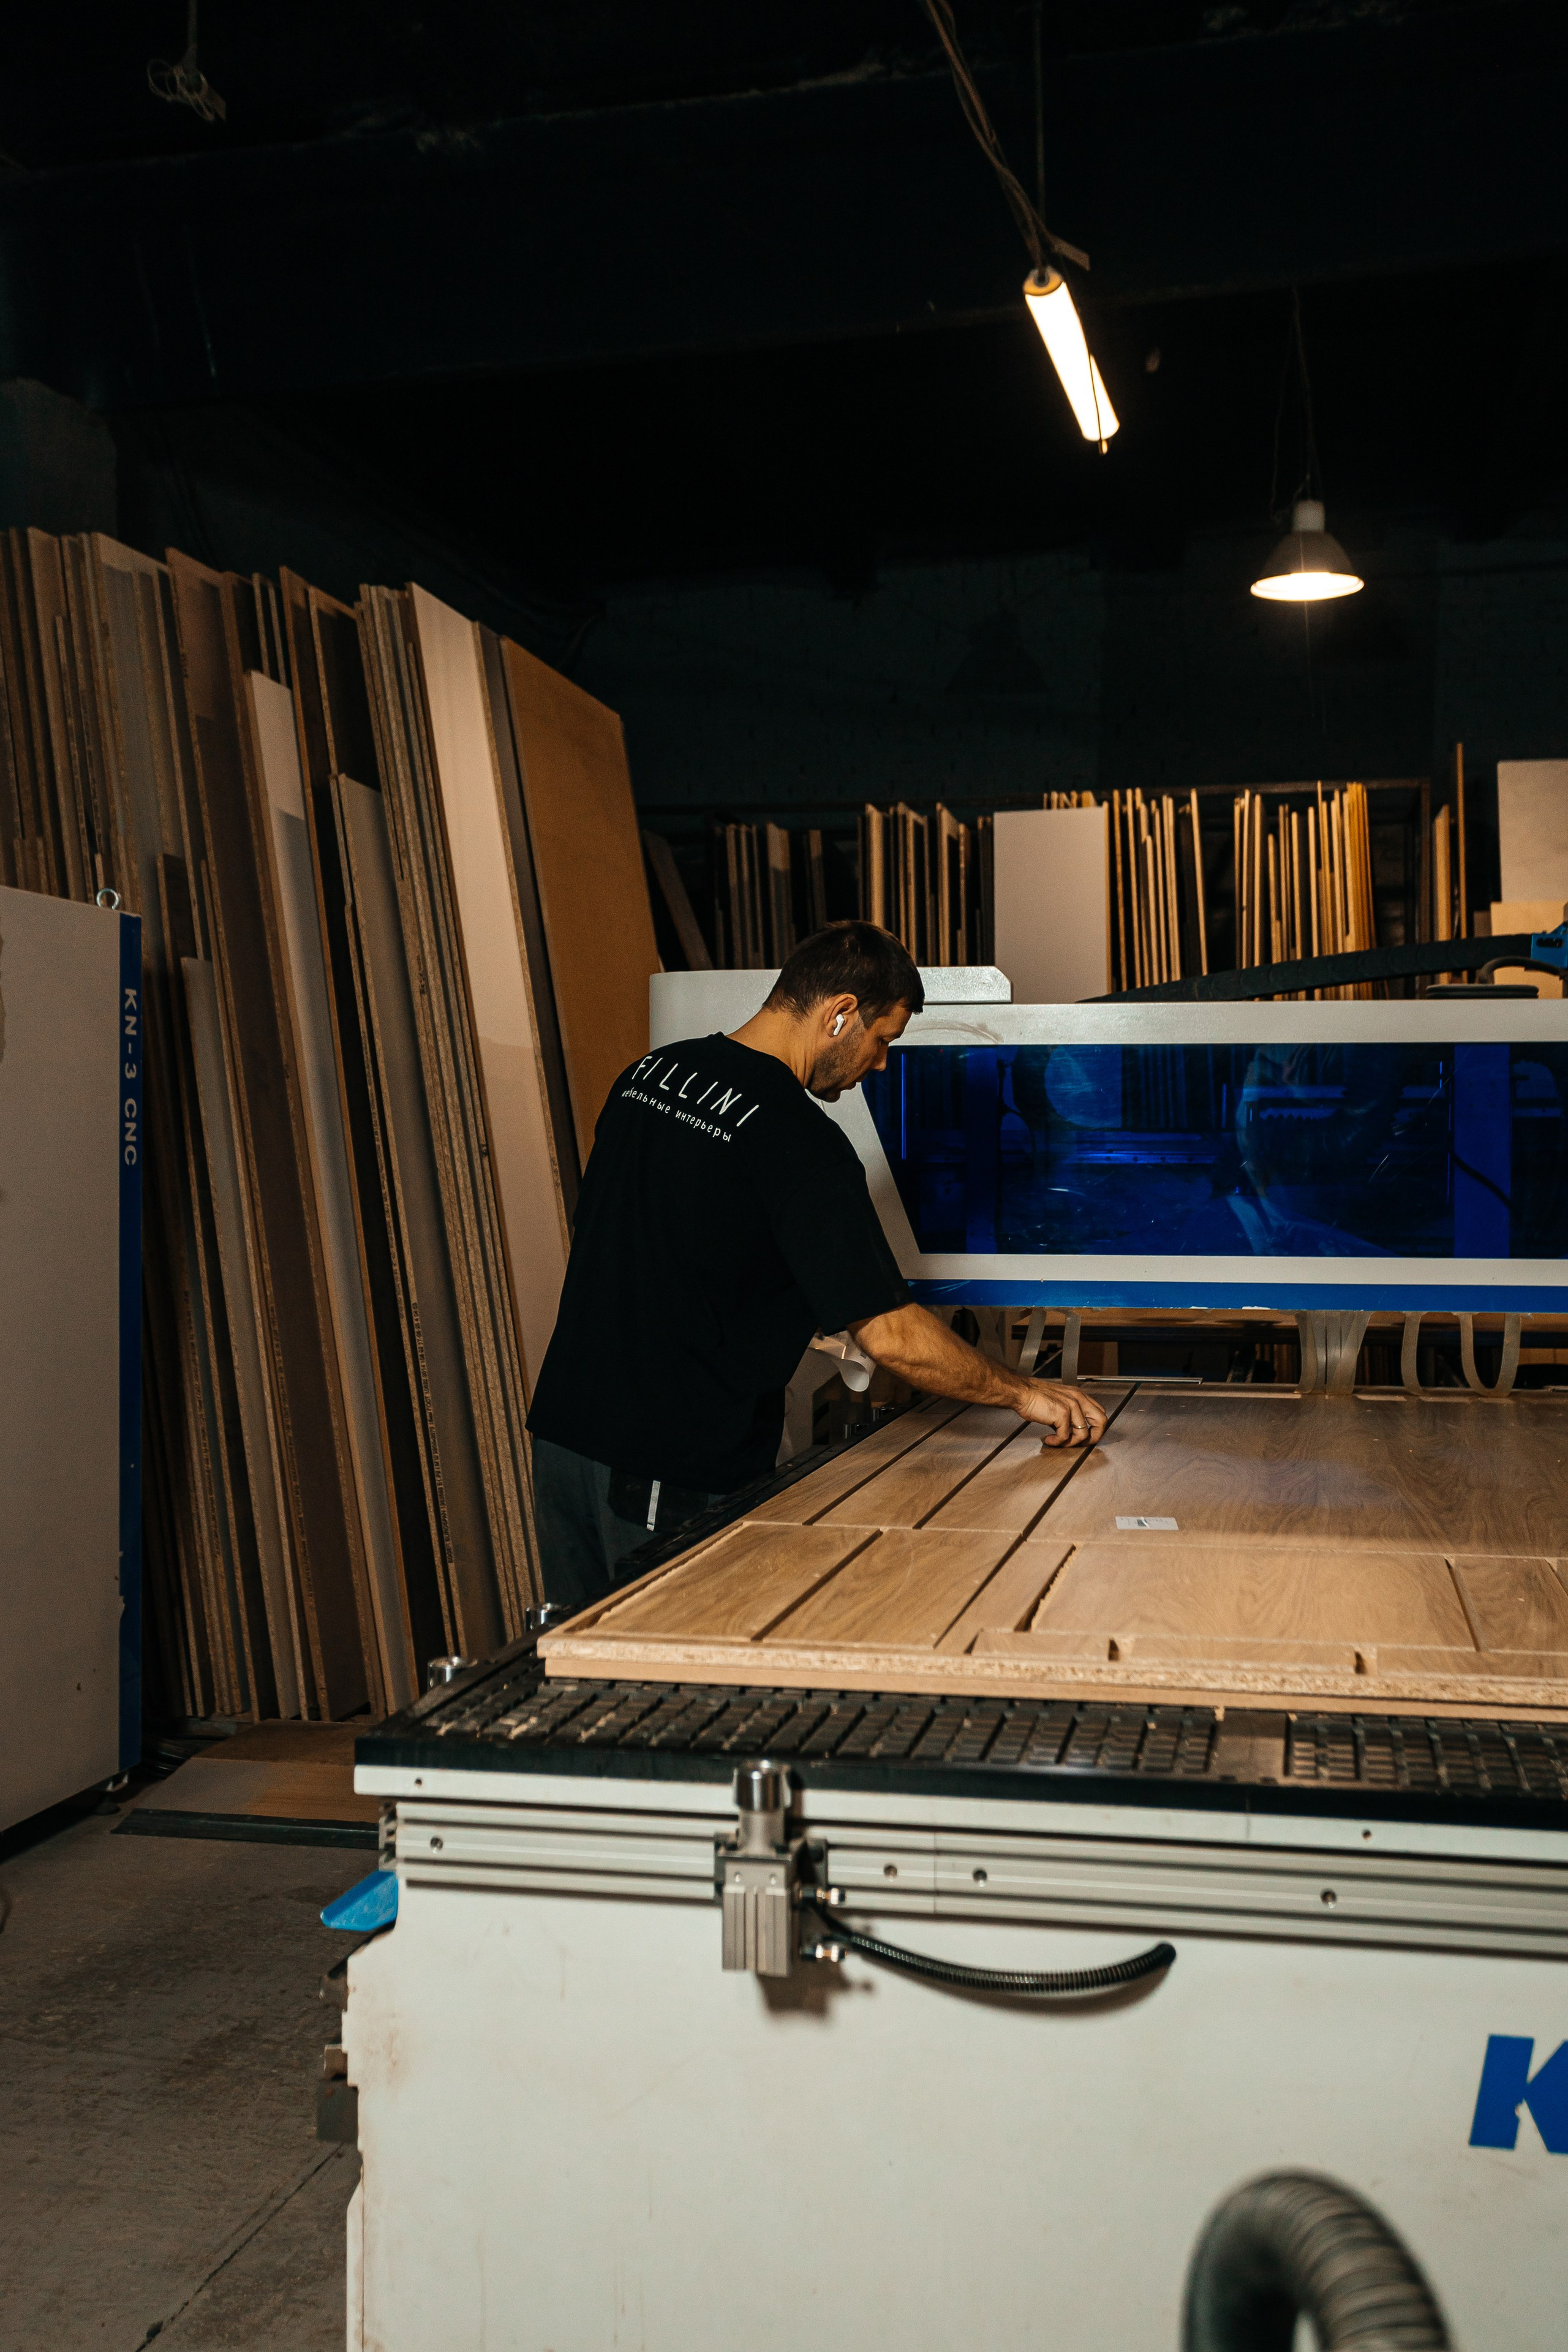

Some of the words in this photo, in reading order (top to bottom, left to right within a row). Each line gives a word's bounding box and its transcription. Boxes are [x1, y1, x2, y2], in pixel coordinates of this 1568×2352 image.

[124, 988, 138, 1080] KN-3
[631, 1055, 760, 1128] FILLINI
[674, 1109, 732, 1142] интерьеры
[124, 1097, 138, 1166] CNC
[1468, 2034, 1568, 2154] K
